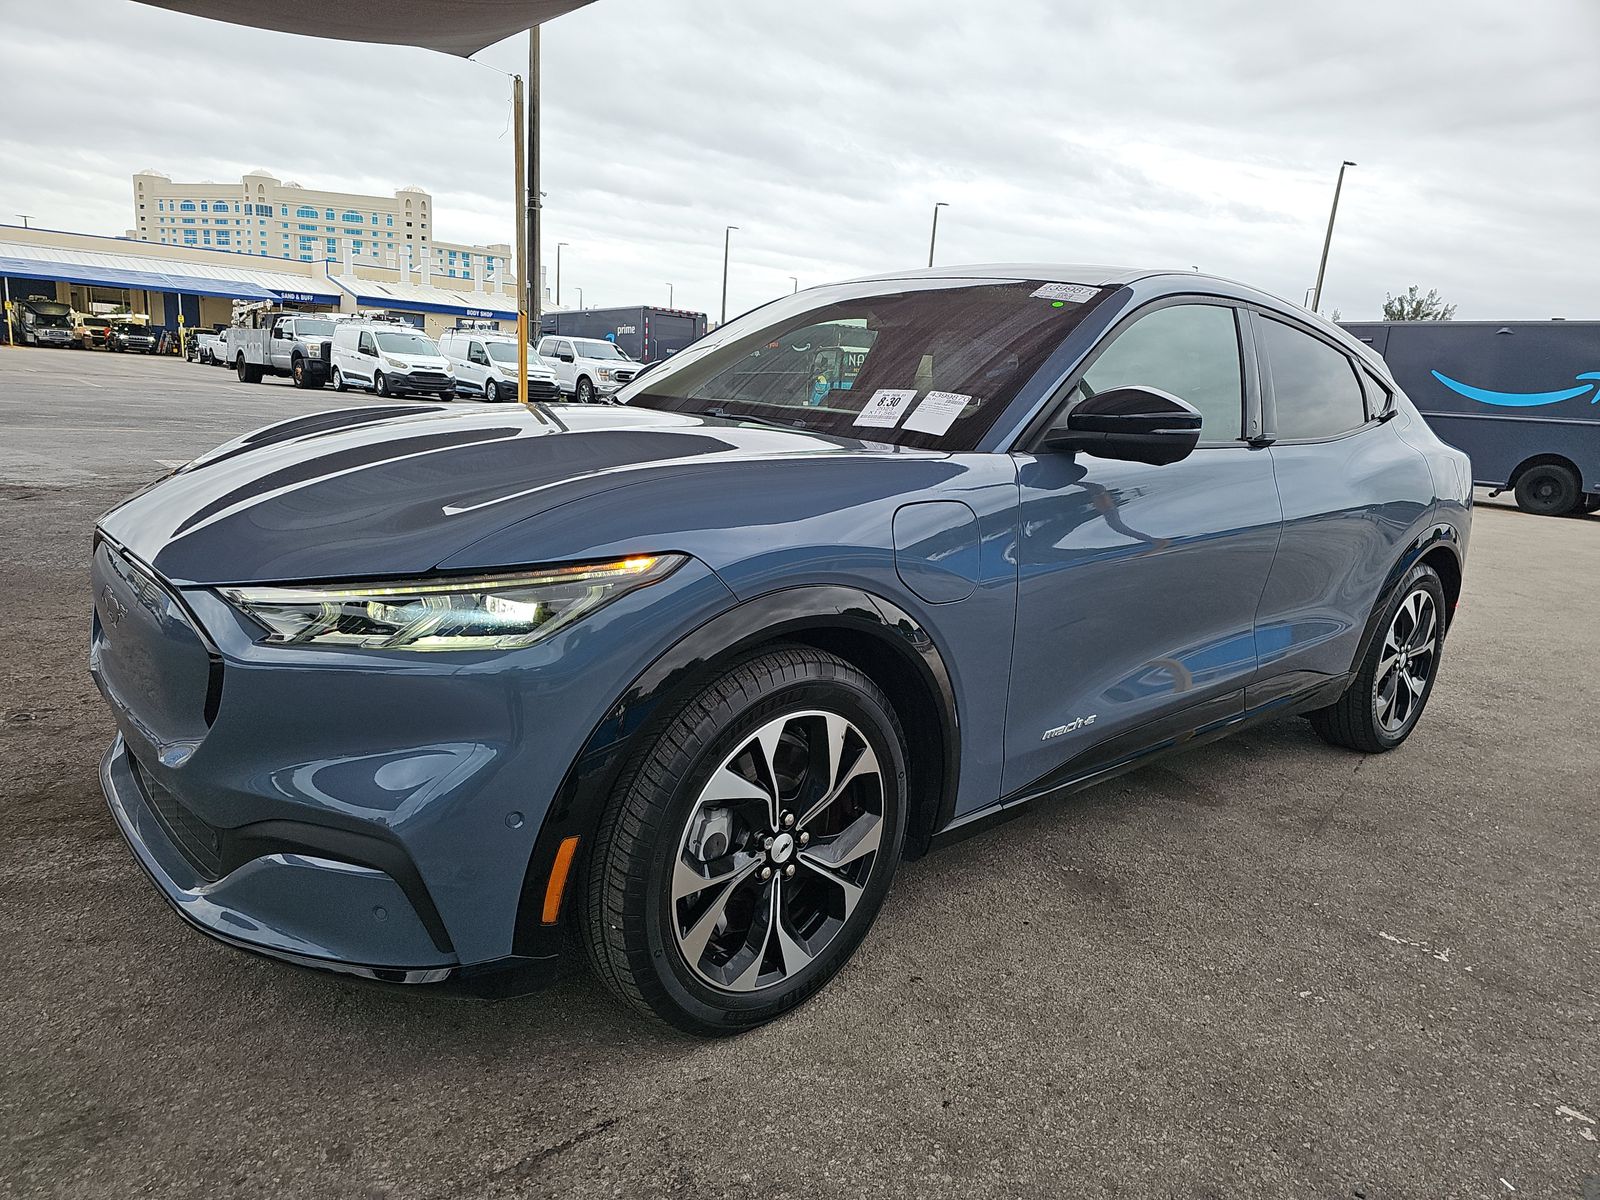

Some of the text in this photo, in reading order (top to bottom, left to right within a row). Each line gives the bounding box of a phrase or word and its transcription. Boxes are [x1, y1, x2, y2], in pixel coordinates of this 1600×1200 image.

[281, 292, 295, 300] SAND
[300, 294, 314, 302] BUFF
[617, 324, 636, 336] prime
[877, 396, 901, 407] 8:30
[930, 392, 971, 403] 4399870
